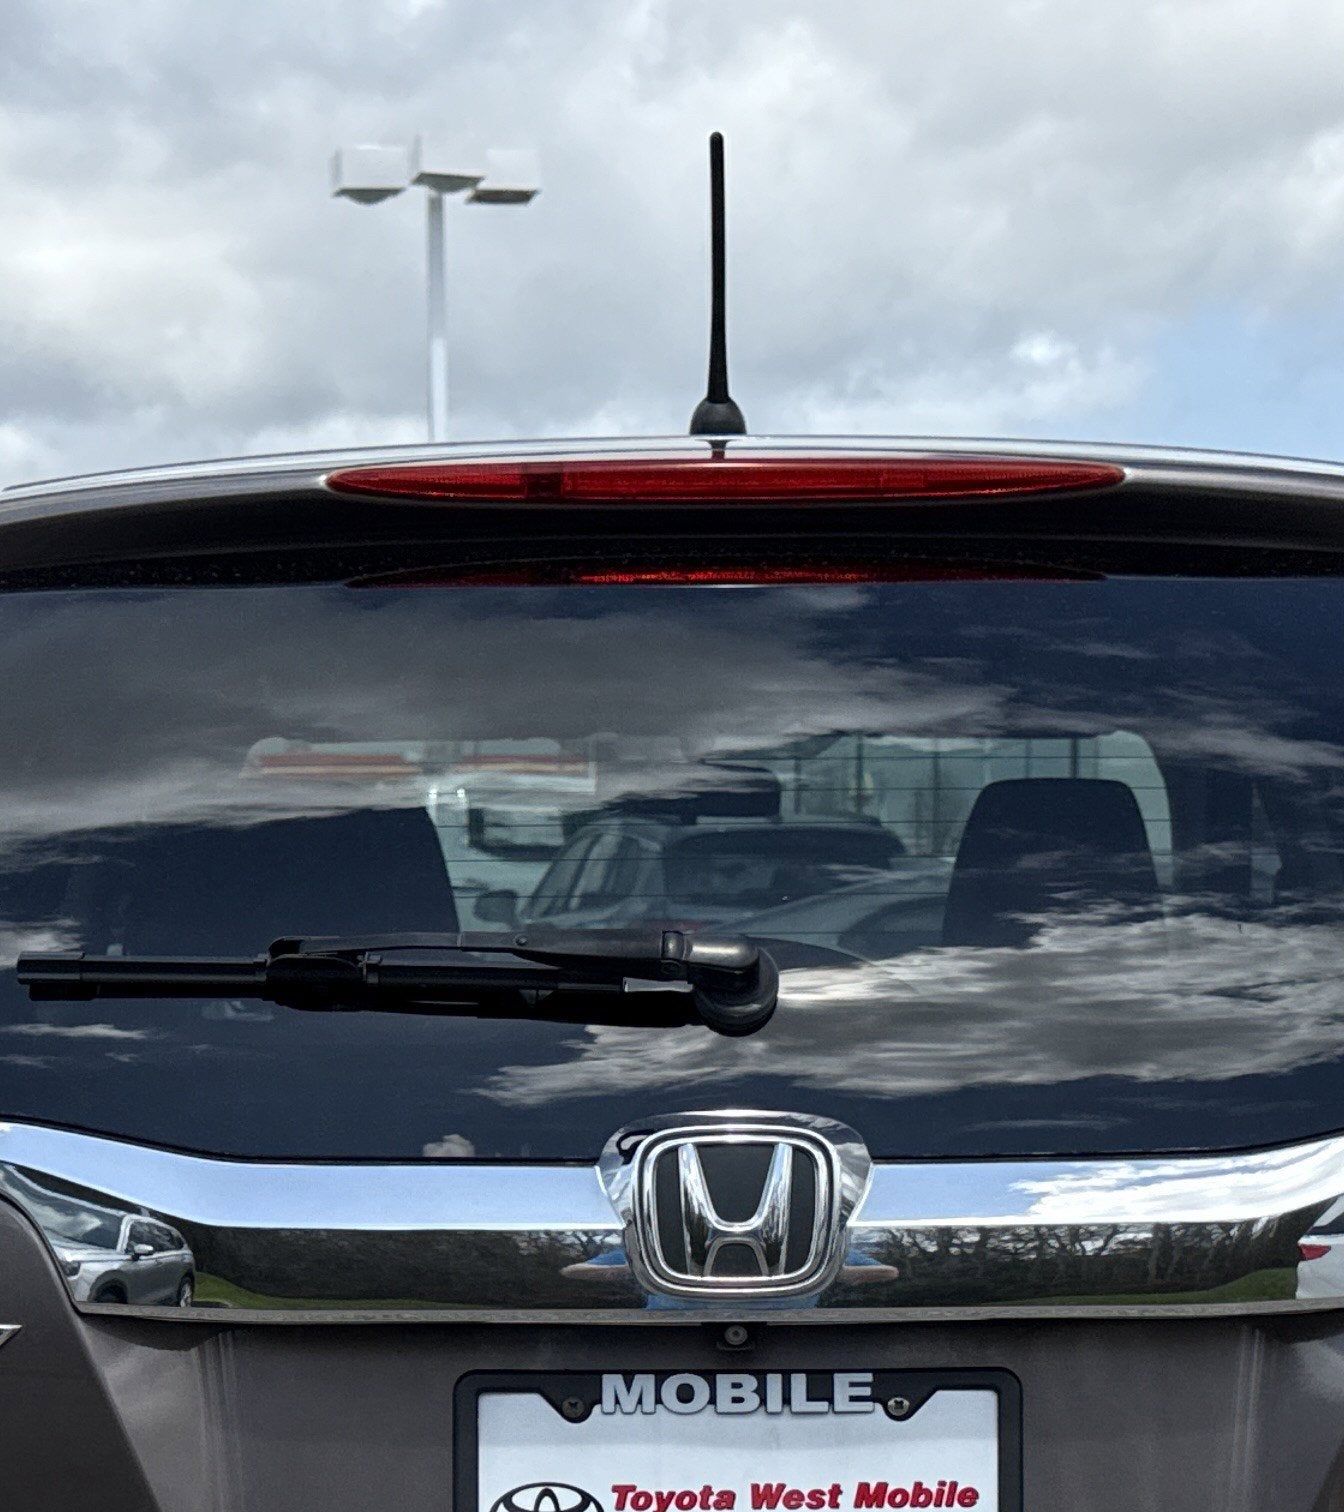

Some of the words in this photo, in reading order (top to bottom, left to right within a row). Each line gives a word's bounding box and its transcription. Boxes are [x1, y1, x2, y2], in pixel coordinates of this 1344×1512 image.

[601, 1373, 875, 1415] MOBILE
[750, 1483, 843, 1511] West
[855, 1481, 981, 1509] Mobile
